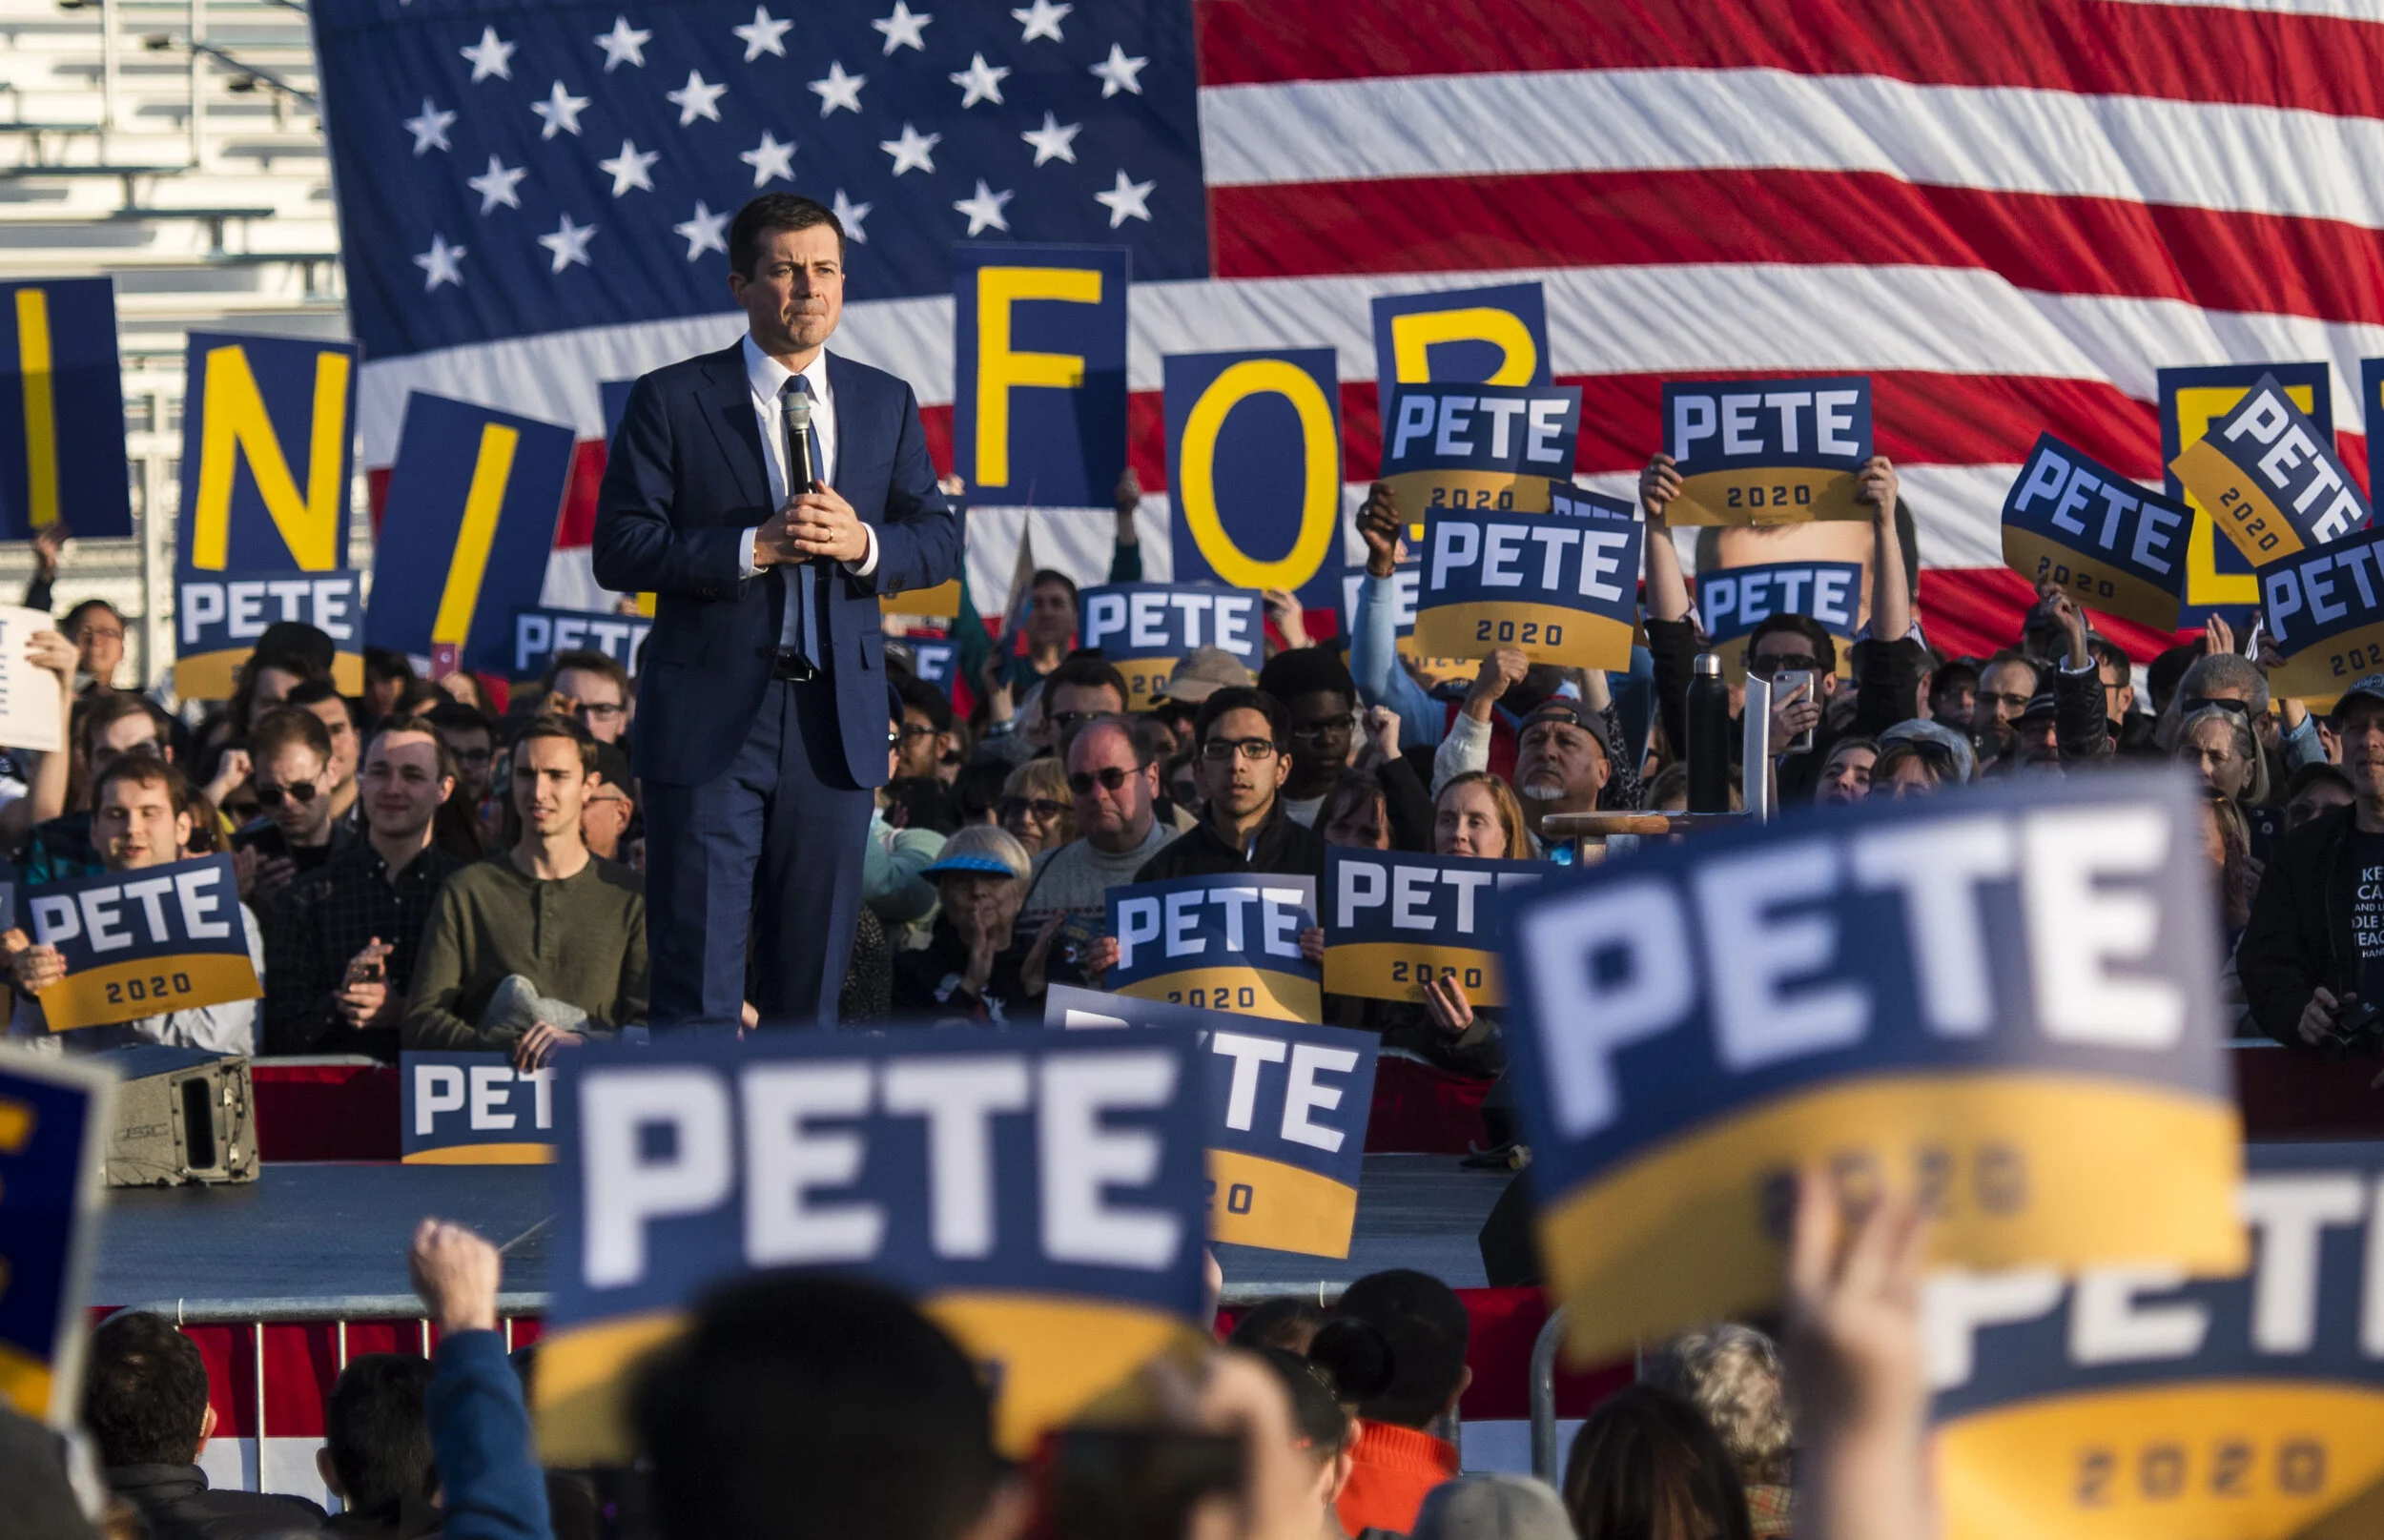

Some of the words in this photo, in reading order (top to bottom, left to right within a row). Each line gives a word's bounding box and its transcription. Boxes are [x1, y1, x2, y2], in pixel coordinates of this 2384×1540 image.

[976, 267, 1102, 487] F
[192, 344, 351, 571] N
[1391, 394, 1572, 463] PETE
[1674, 389, 1860, 462] PETE
[1180, 359, 1340, 589] O
[1431, 487, 1513, 509] 2020
[1727, 484, 1811, 507] 2020
[2223, 389, 2363, 545] PETE
[2014, 447, 2183, 574] PETE
[2219, 487, 2280, 551] 2020
[1430, 521, 1630, 602] PETE
[2038, 555, 2114, 598] 2020
[2265, 540, 2384, 644] PET
[180, 578, 353, 645] PETE
[1085, 592, 1254, 656] PETE
[1476, 620, 1562, 646] 2020
[1704, 569, 1852, 637] PETE
[1132, 674, 1166, 695] 20
[29, 866, 231, 953] PETE
[1118, 887, 1305, 970] PETE
[1337, 859, 1543, 934] PET
[2354, 903, 2376, 912] AND
[106, 972, 192, 1005] 2020
[1167, 987, 1255, 1009] 2020
[1392, 961, 1482, 988] 2020
[1526, 801, 2185, 1138] PETE
[414, 1065, 559, 1136] PET
[580, 1050, 1183, 1289] PETE
[2072, 1436, 2330, 1509] 2020
